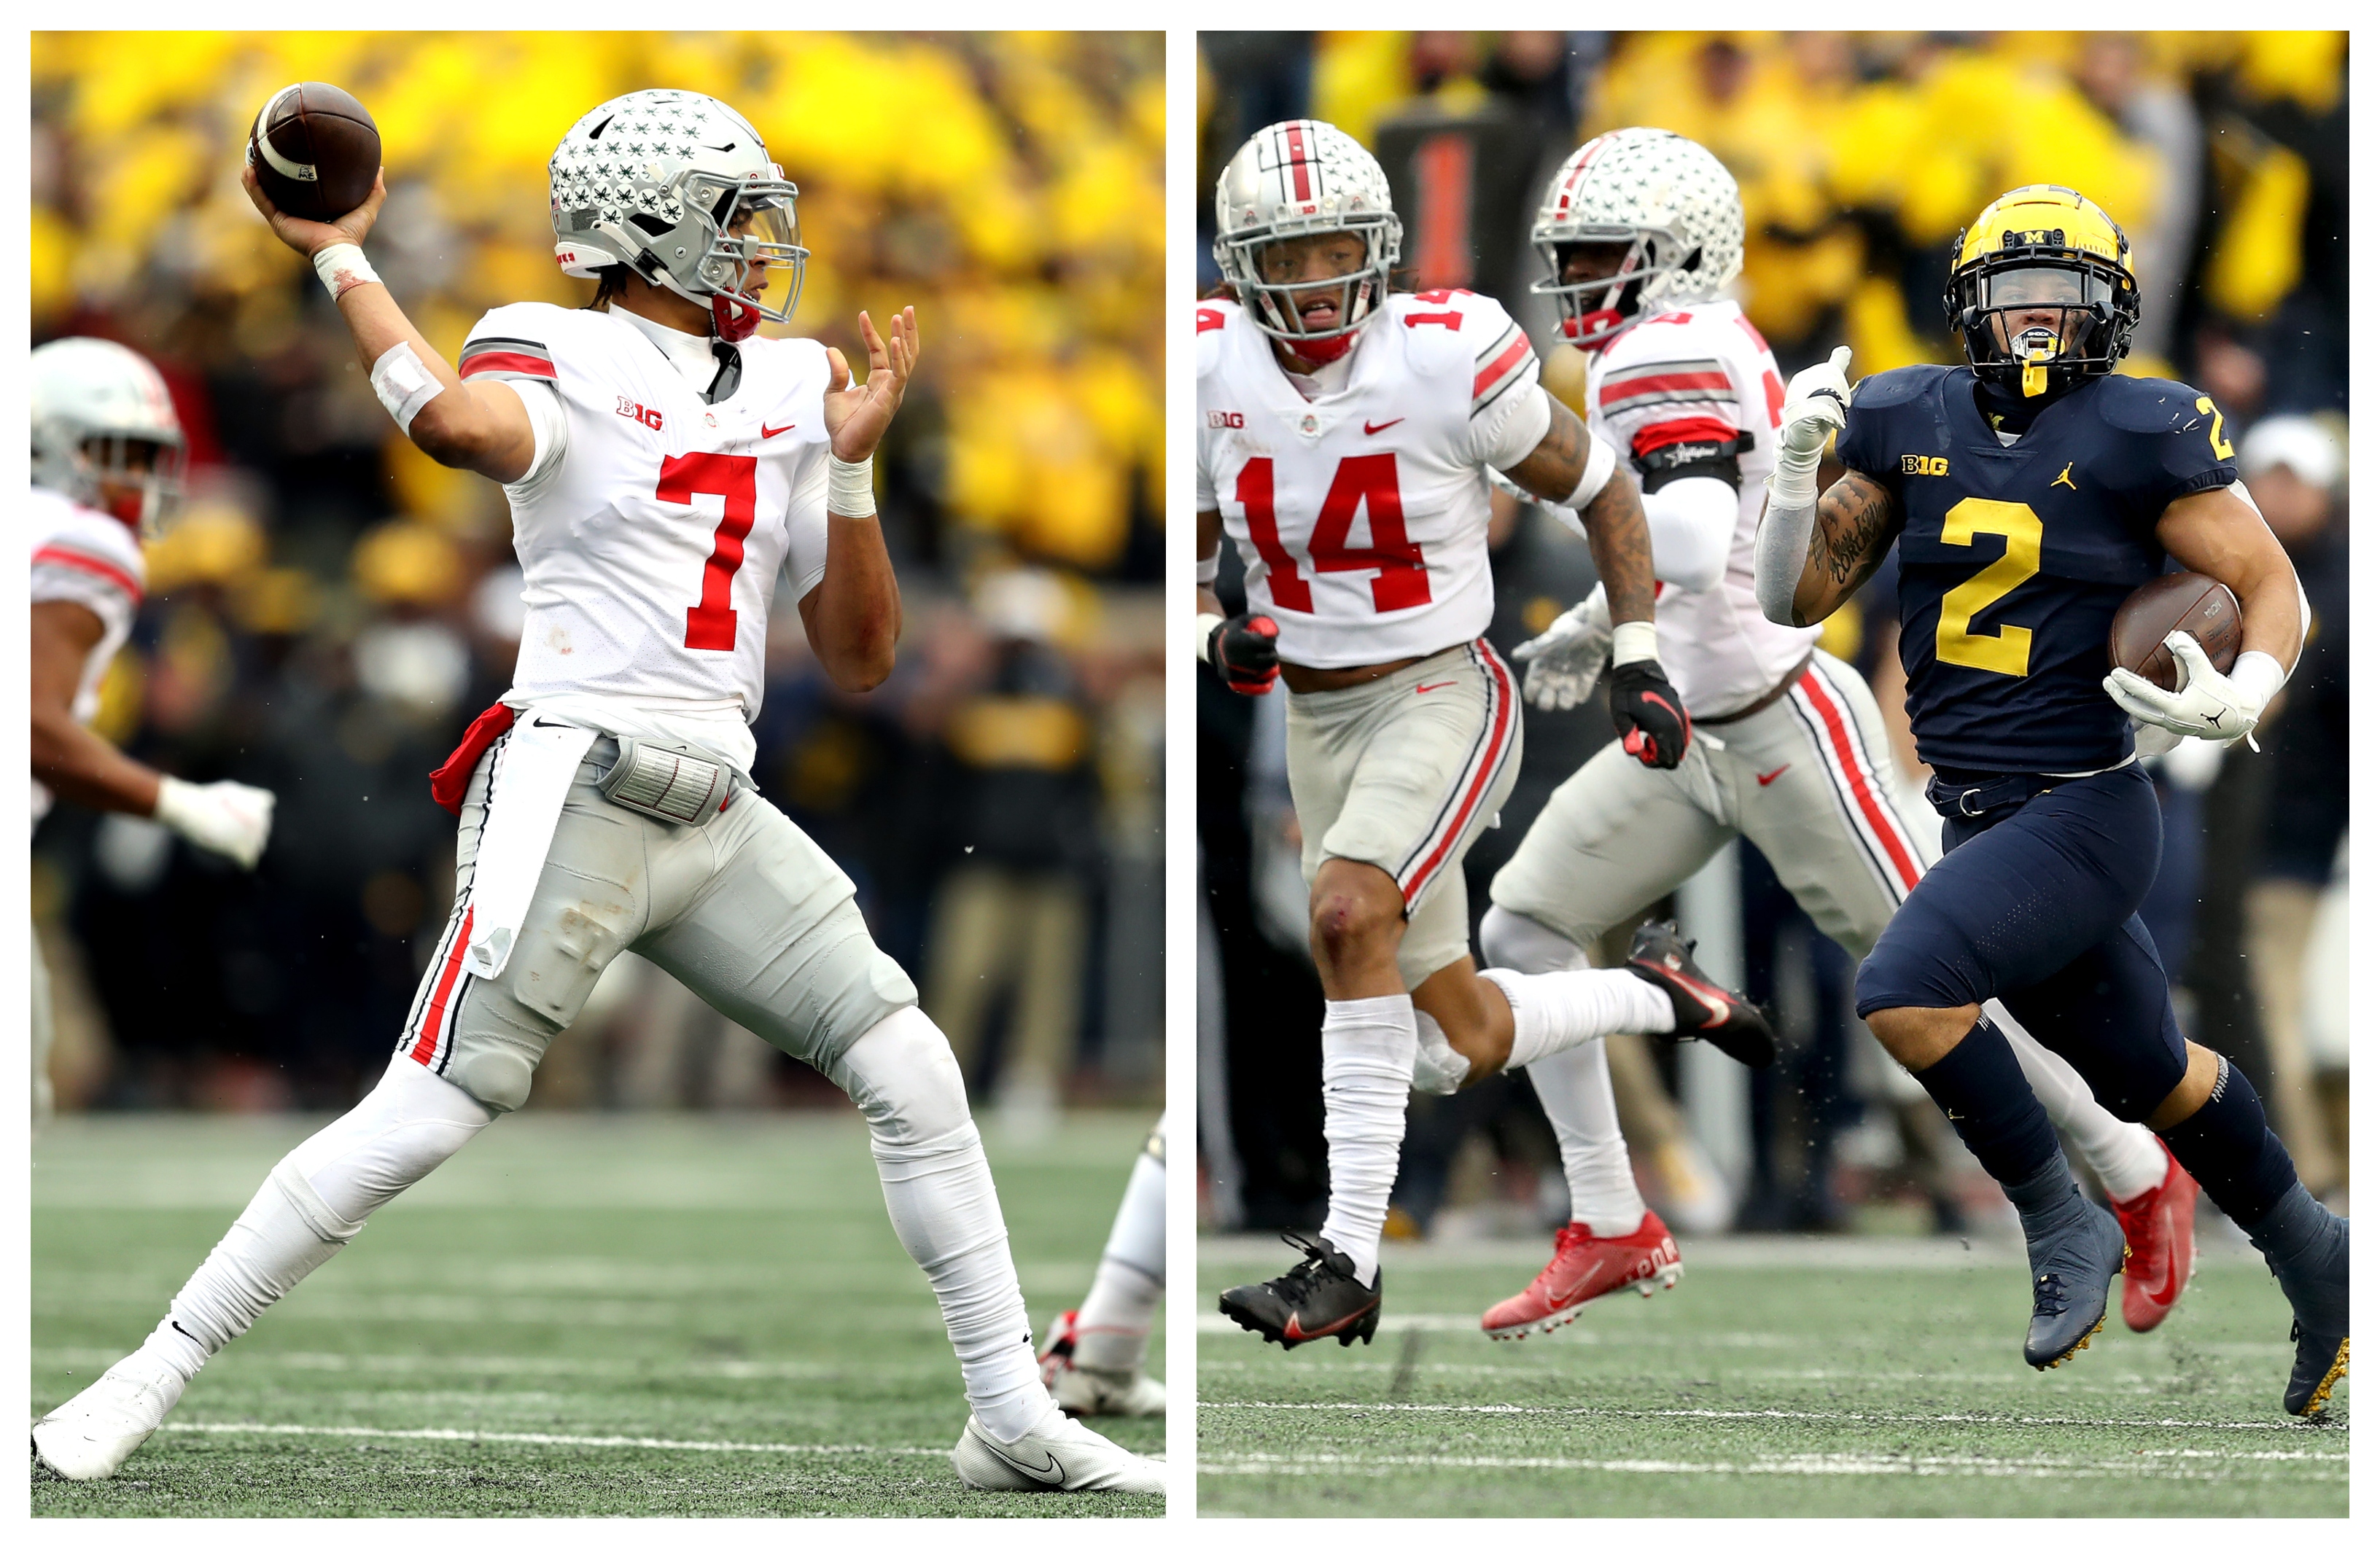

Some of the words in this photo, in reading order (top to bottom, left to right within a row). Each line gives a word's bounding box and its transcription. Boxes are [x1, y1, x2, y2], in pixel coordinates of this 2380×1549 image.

[2025, 230, 2045, 244] M
[2196, 397, 2235, 461] 2
[656, 452, 758, 651] 7
[1235, 453, 1432, 614] 14
[1936, 496, 2043, 676] 2
